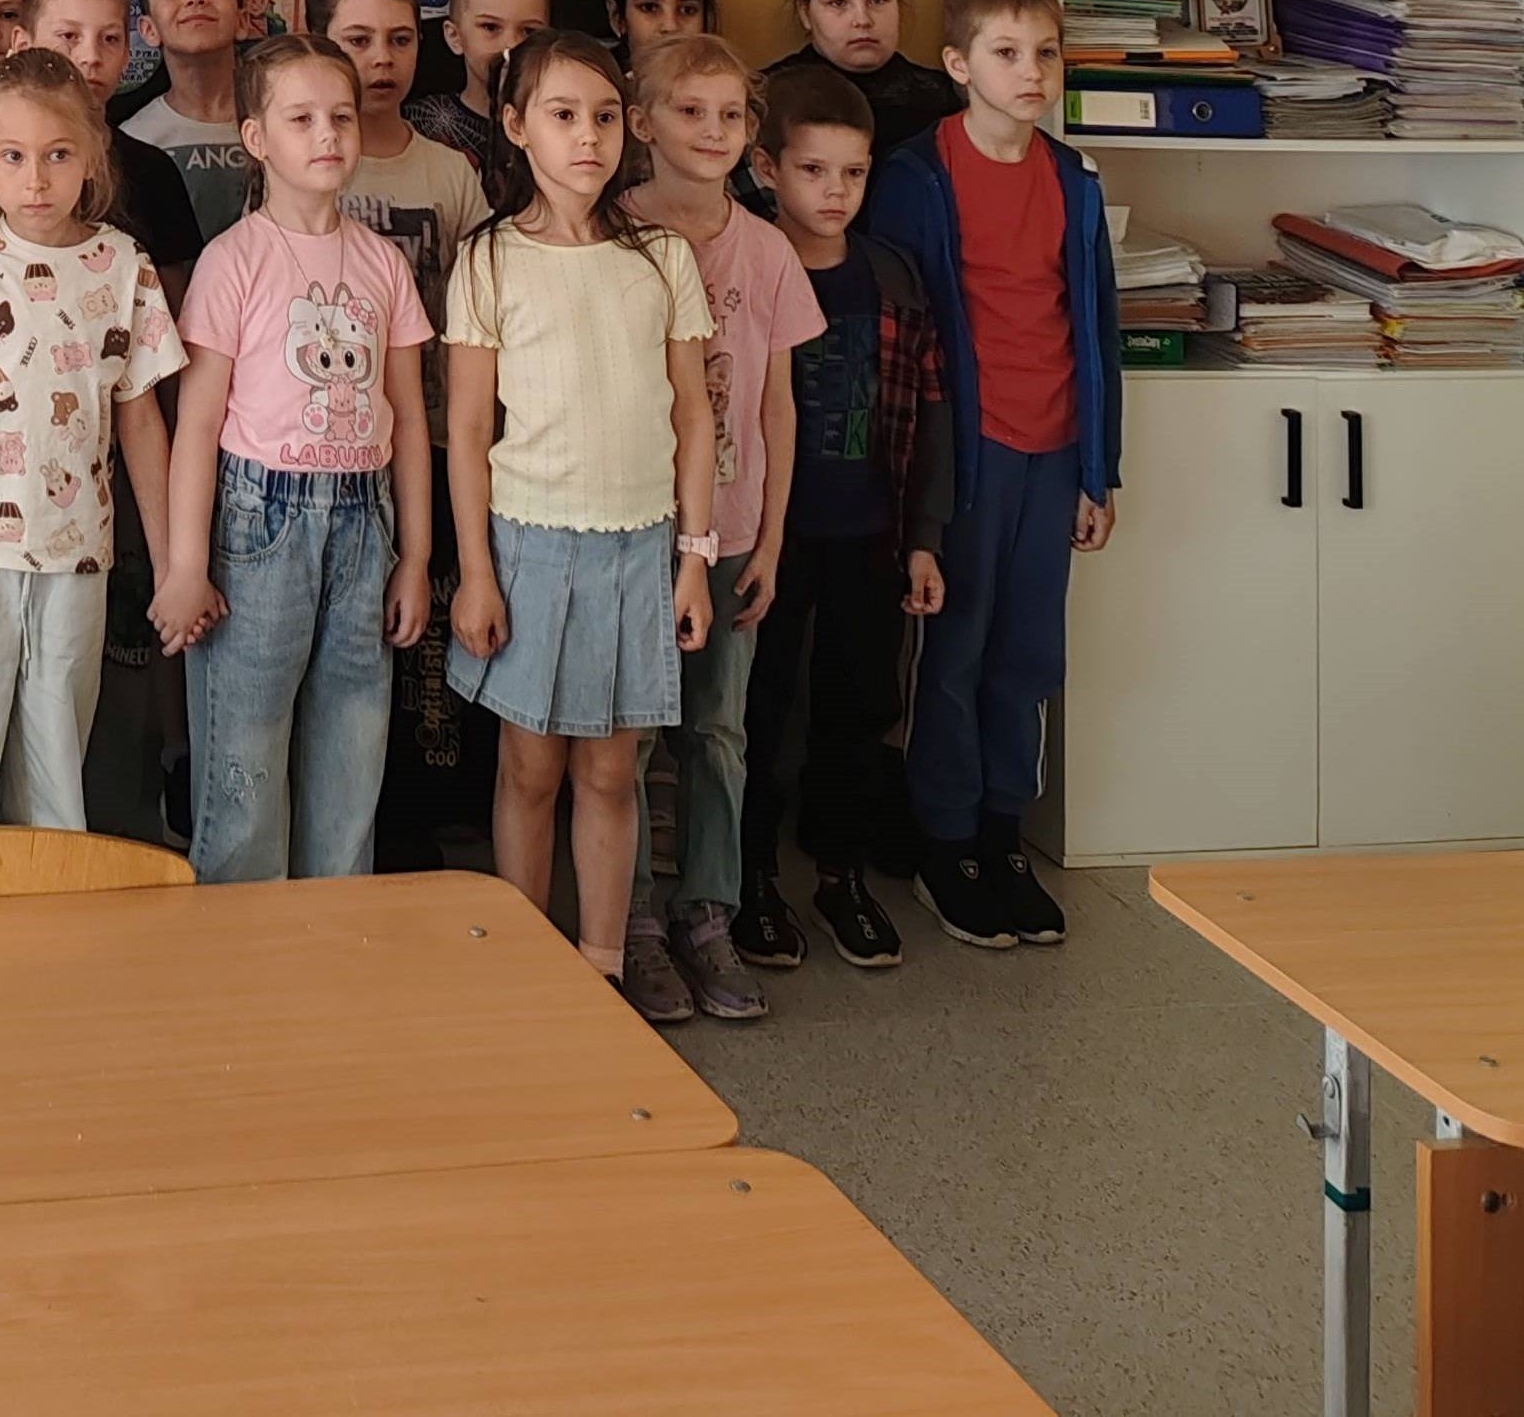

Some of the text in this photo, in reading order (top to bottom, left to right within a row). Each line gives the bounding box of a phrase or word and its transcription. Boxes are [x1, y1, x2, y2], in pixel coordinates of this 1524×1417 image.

[185, 145, 246, 170] ANG
[340, 193, 392, 232] GHT
[280, 443, 383, 469] LABUBU
